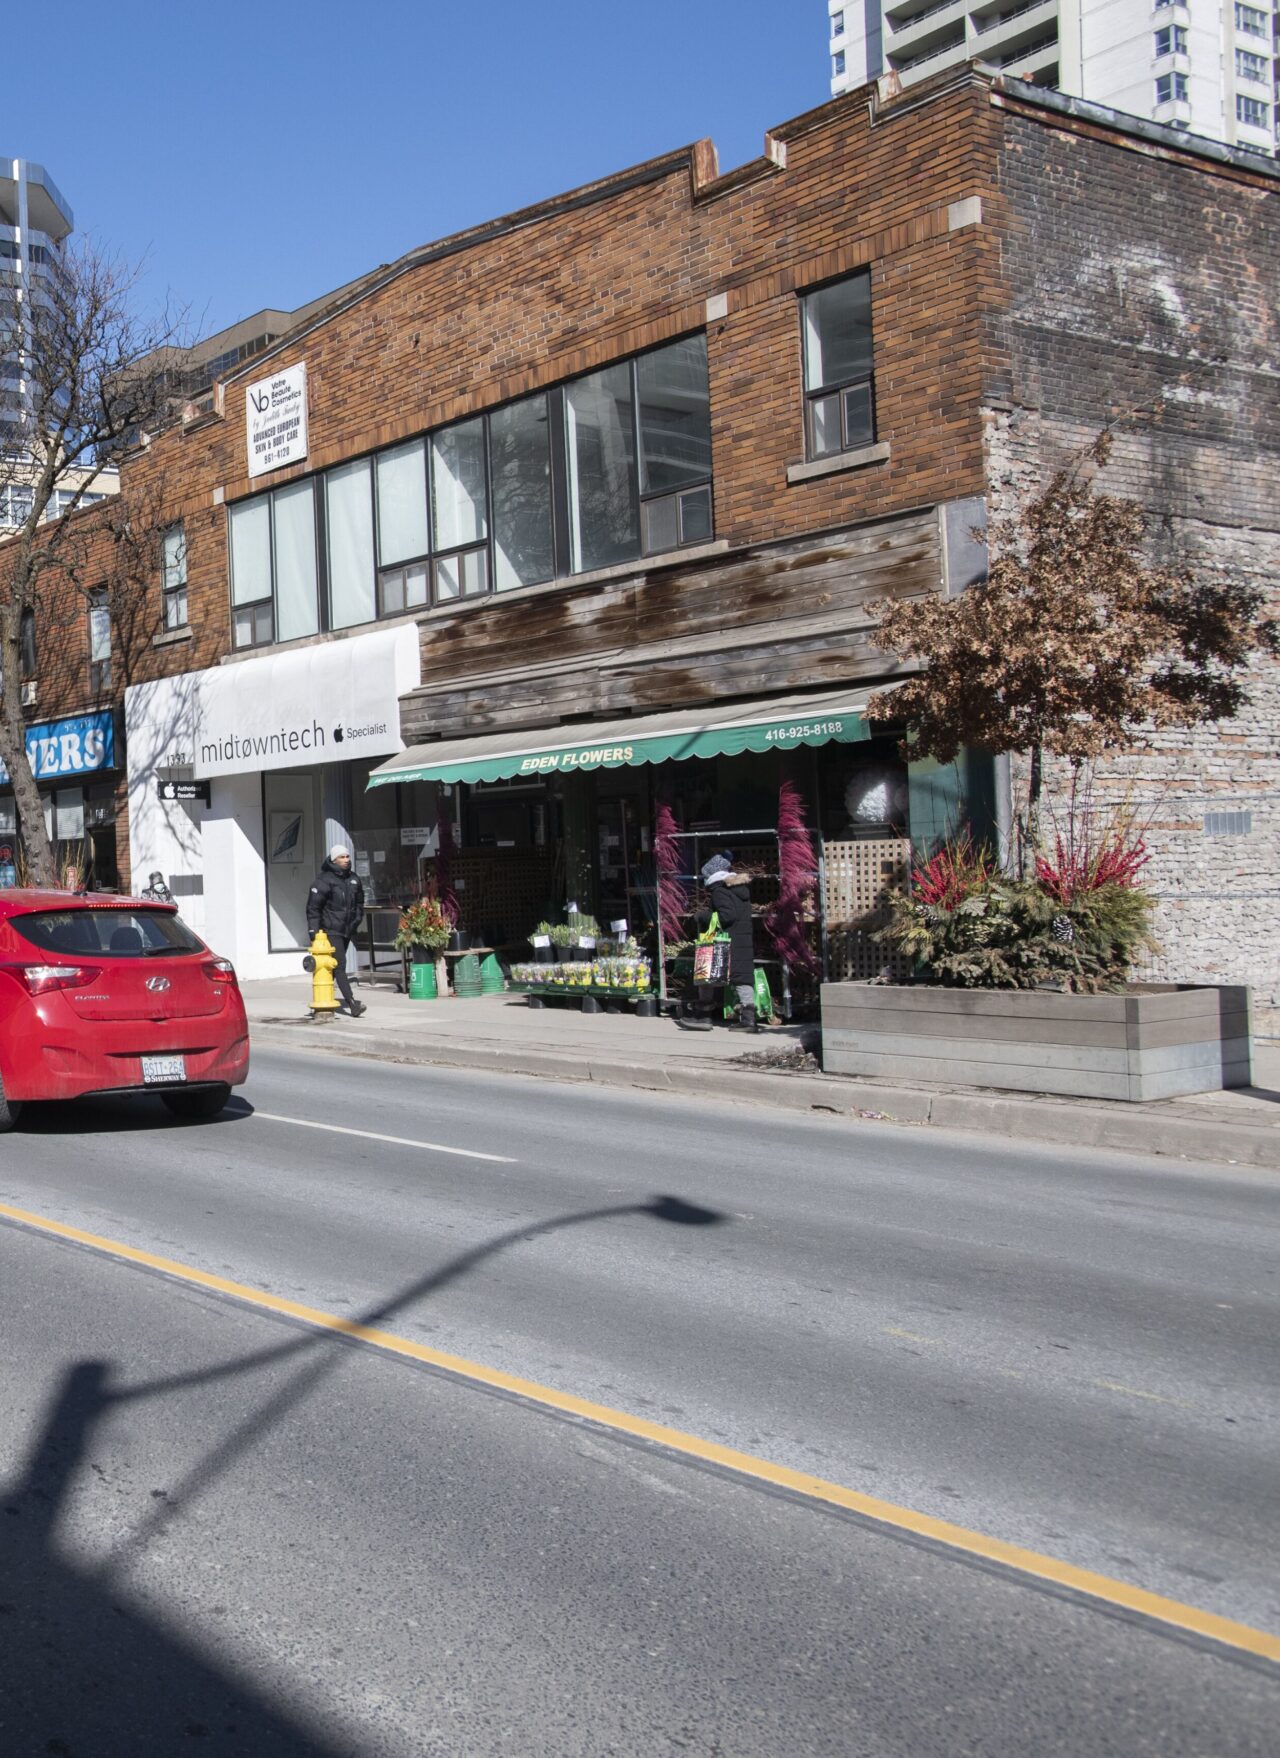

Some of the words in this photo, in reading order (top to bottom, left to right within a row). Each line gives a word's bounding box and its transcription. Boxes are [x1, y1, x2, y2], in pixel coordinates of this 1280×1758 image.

[271, 379, 287, 390] Votre
[271, 390, 302, 408] Cosmetics
[253, 426, 276, 443] ADVANCED
[277, 416, 300, 434] EUROPEAN
[255, 441, 267, 454] SKIN
[268, 439, 272, 450] &
[273, 434, 286, 448] BODY
[286, 428, 299, 442] CARE
[346, 723, 388, 740] Specialist
[765, 721, 844, 741] 416-925-8188
[167, 752, 186, 767] 1393
[520, 755, 560, 770] EDEN
[561, 746, 634, 766] FLOWERS
[150, 1074, 181, 1083] SHERWAY
